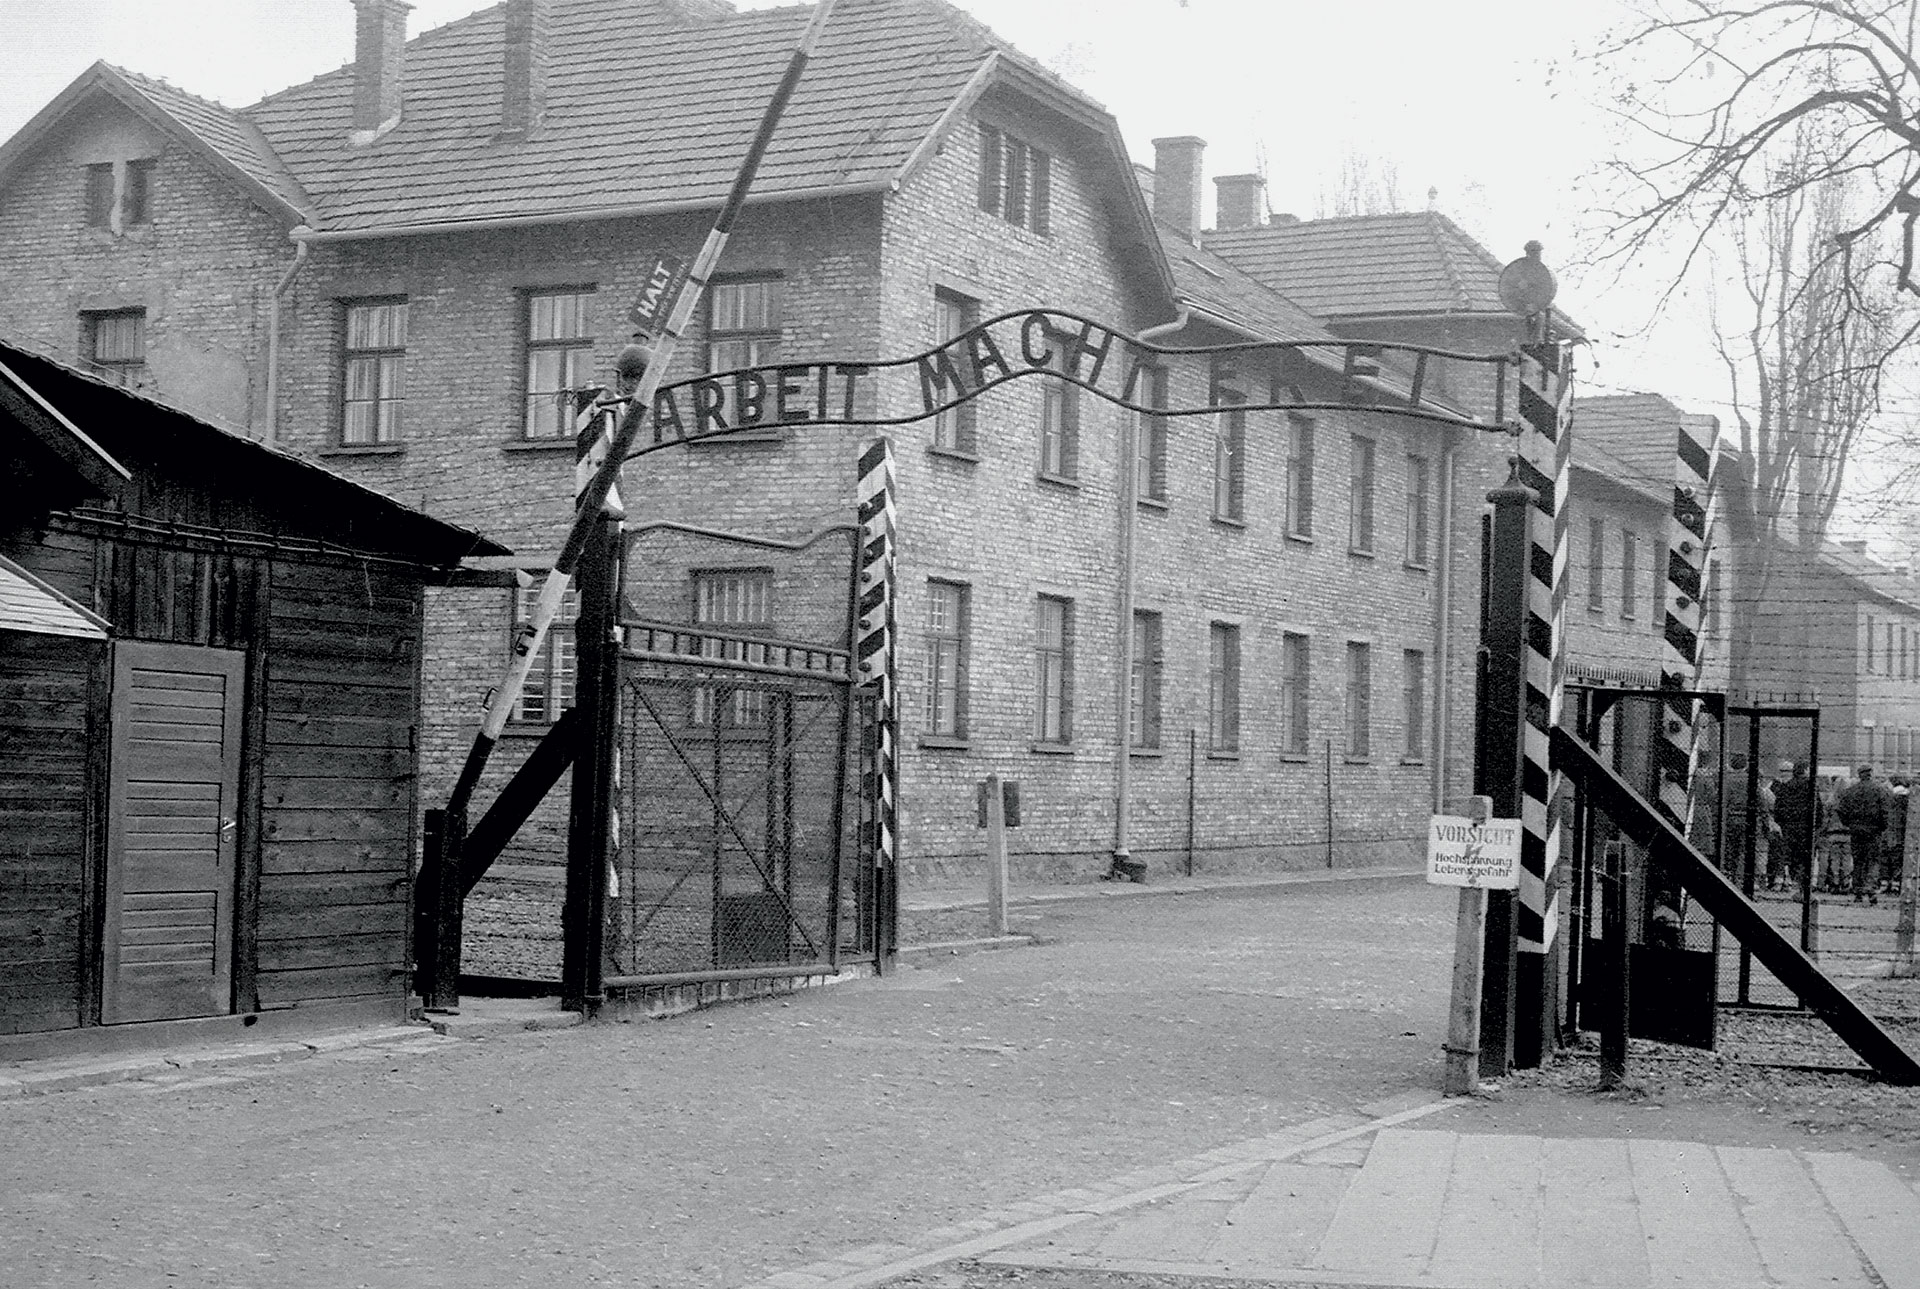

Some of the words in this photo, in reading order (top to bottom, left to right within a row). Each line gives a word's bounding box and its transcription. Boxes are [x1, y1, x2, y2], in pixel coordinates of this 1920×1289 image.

[637, 260, 671, 318] HALT
[653, 364, 868, 443] ARBEIT
[1436, 824, 1514, 846] VORSICHT
